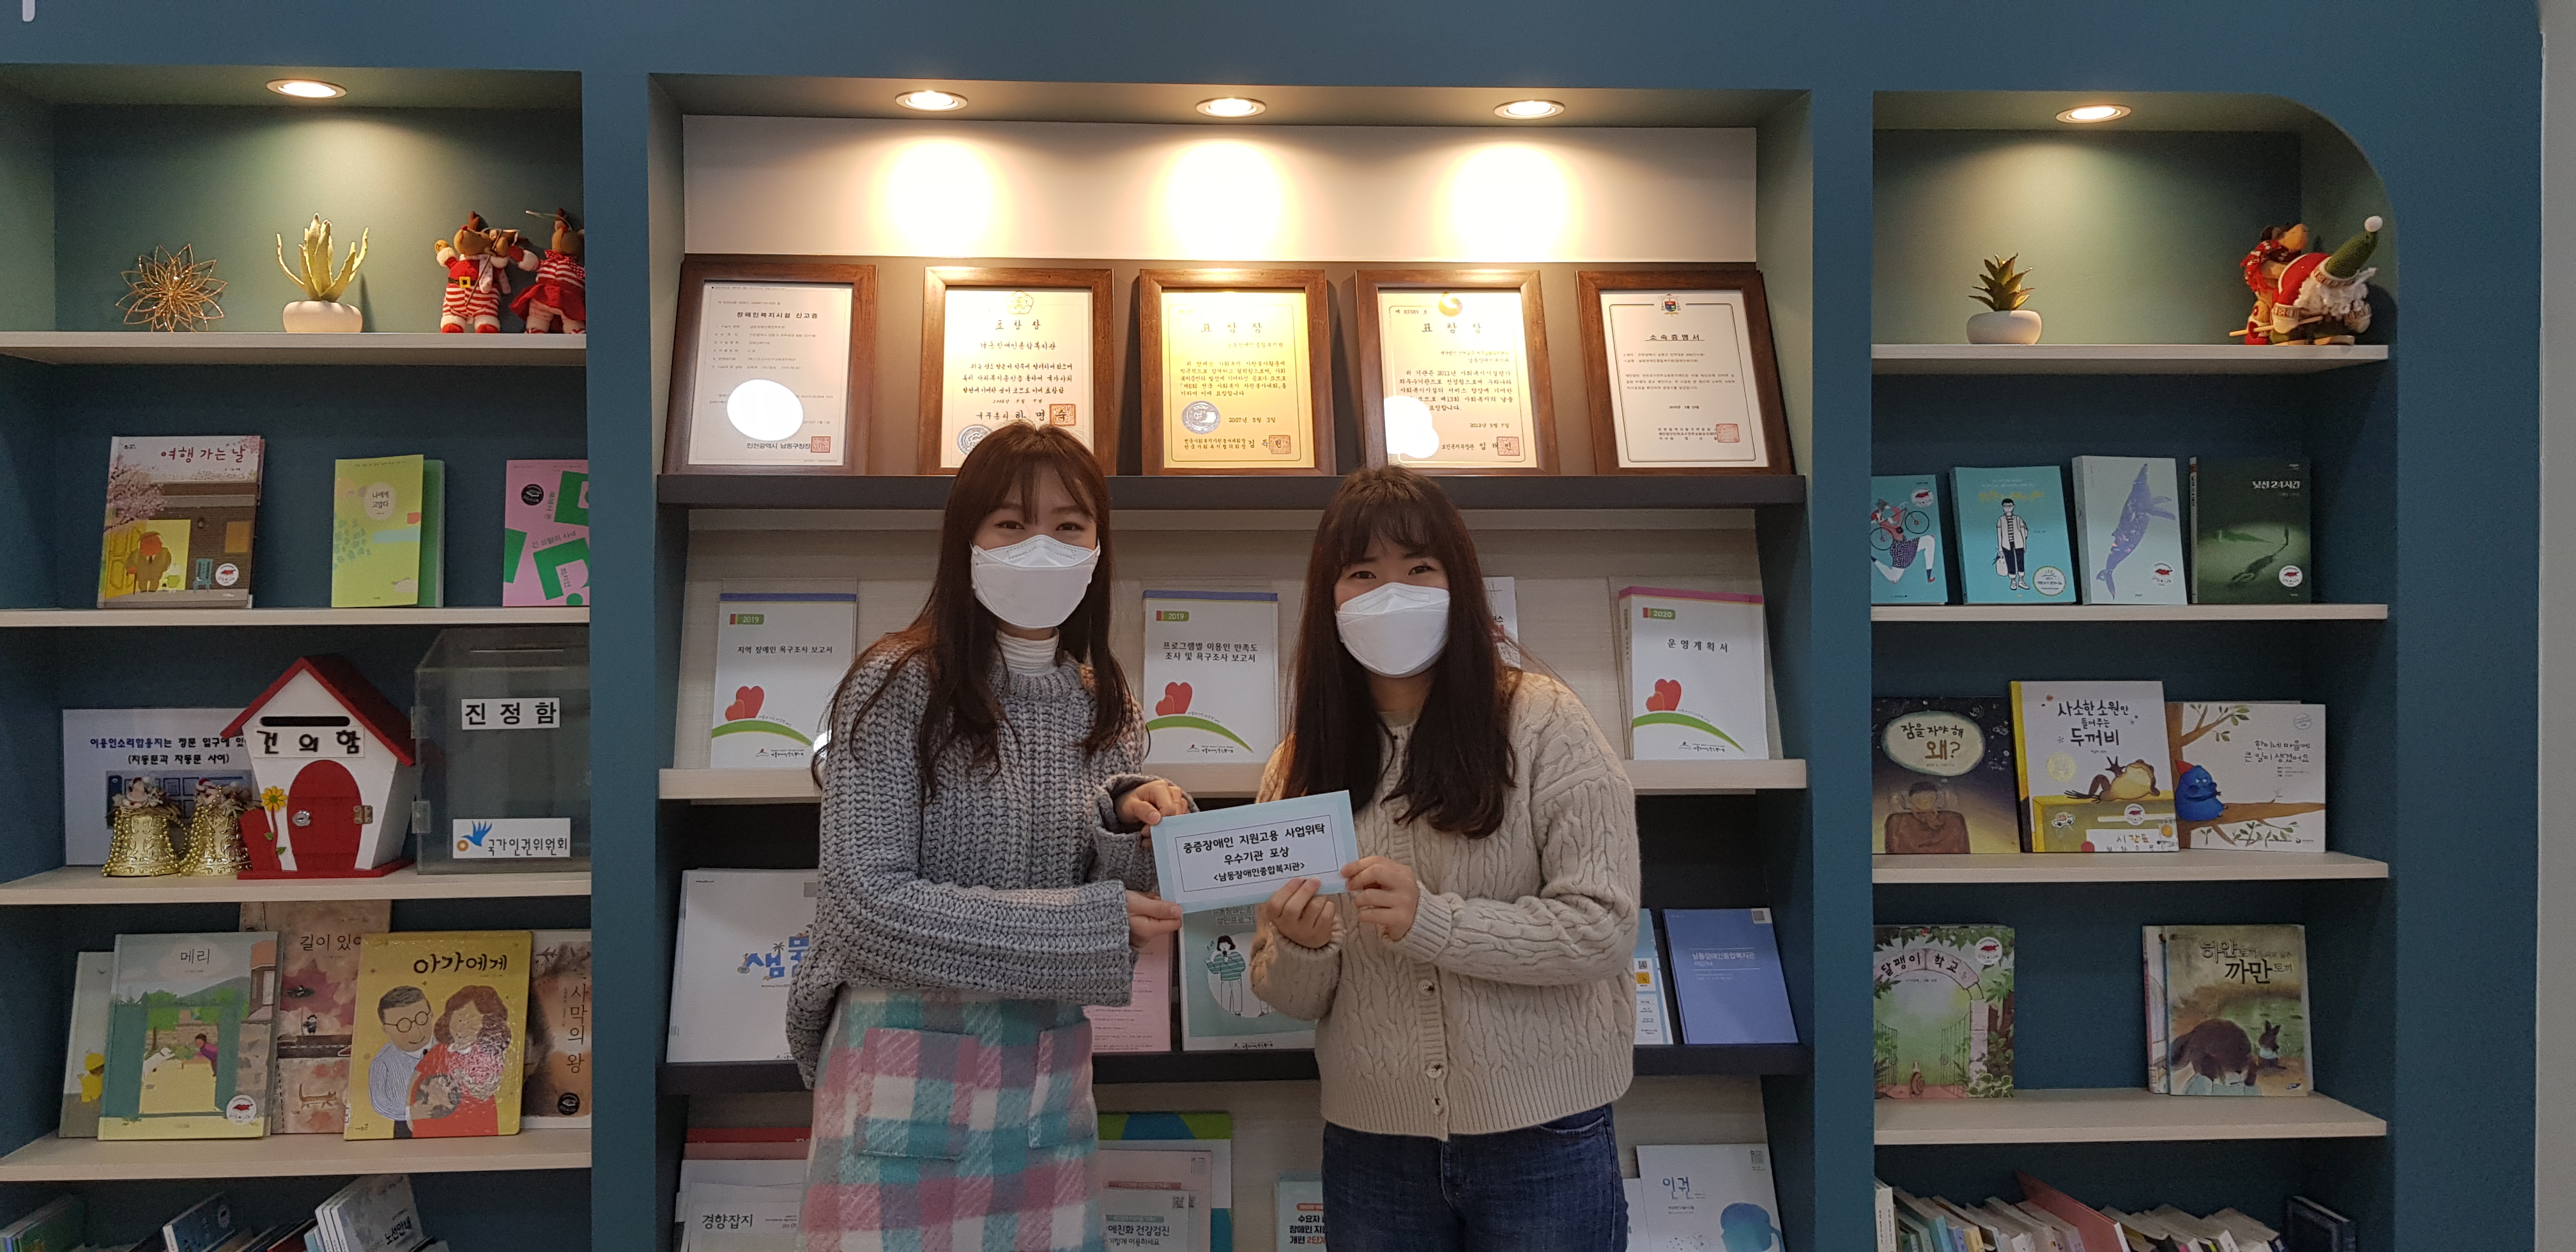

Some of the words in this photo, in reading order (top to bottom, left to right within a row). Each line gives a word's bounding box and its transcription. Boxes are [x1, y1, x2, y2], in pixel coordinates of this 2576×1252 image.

[161, 447, 194, 463] 여행
[200, 448, 226, 461] 가는
[232, 446, 245, 462] 날
[1653, 610, 1673, 619] 2020
[1163, 642, 1202, 651] 프로그램별
[1207, 643, 1230, 652] 이용인
[1234, 643, 1259, 652] 만족도
[1165, 652, 1181, 660] 조사
[1185, 652, 1192, 660] 및
[1196, 653, 1228, 662] 욕구조사
[1232, 654, 1255, 663] 보고서
[465, 701, 557, 725] 진정함
[2058, 699, 2095, 717] 사소한
[2097, 699, 2129, 716] 소원만
[1901, 722, 1924, 739] 잠을
[1927, 725, 1949, 737] 자야
[1951, 725, 1964, 738] 해
[2081, 718, 2110, 729] 들어주는
[256, 729, 361, 755] 건의함
[2071, 728, 2119, 747] 두꺼비
[2284, 740, 2310, 751] 마을에
[1924, 739, 1961, 760] 왜?
[2244, 752, 2253, 762] 큰
[2275, 752, 2310, 763] 생겼어요
[1239, 830, 1278, 845] 지원고용
[1285, 823, 1325, 839] 사업위탁
[488, 837, 567, 856] 국가인권위원회
[1224, 850, 1264, 865] 우수기관
[1269, 846, 1289, 859] 포상
[180, 949, 210, 964] 메리
[2201, 940, 2238, 964] 하얀
[413, 952, 507, 974] 아가에게
[1882, 952, 1920, 976] 달팽이
[1935, 953, 1959, 973] 학교
[2225, 959, 2273, 984] 까만
[2273, 963, 2292, 973] 토끼
[567, 982, 589, 1046] 사막의
[566, 1053, 585, 1074] 왕
[1662, 1176, 1693, 1200] 인권
[702, 1214, 753, 1230] 경향잡지
[1108, 1225, 1134, 1235] 애친화
[1137, 1225, 1170, 1237] 건강검진
[1289, 1225, 1312, 1233] 장애인
